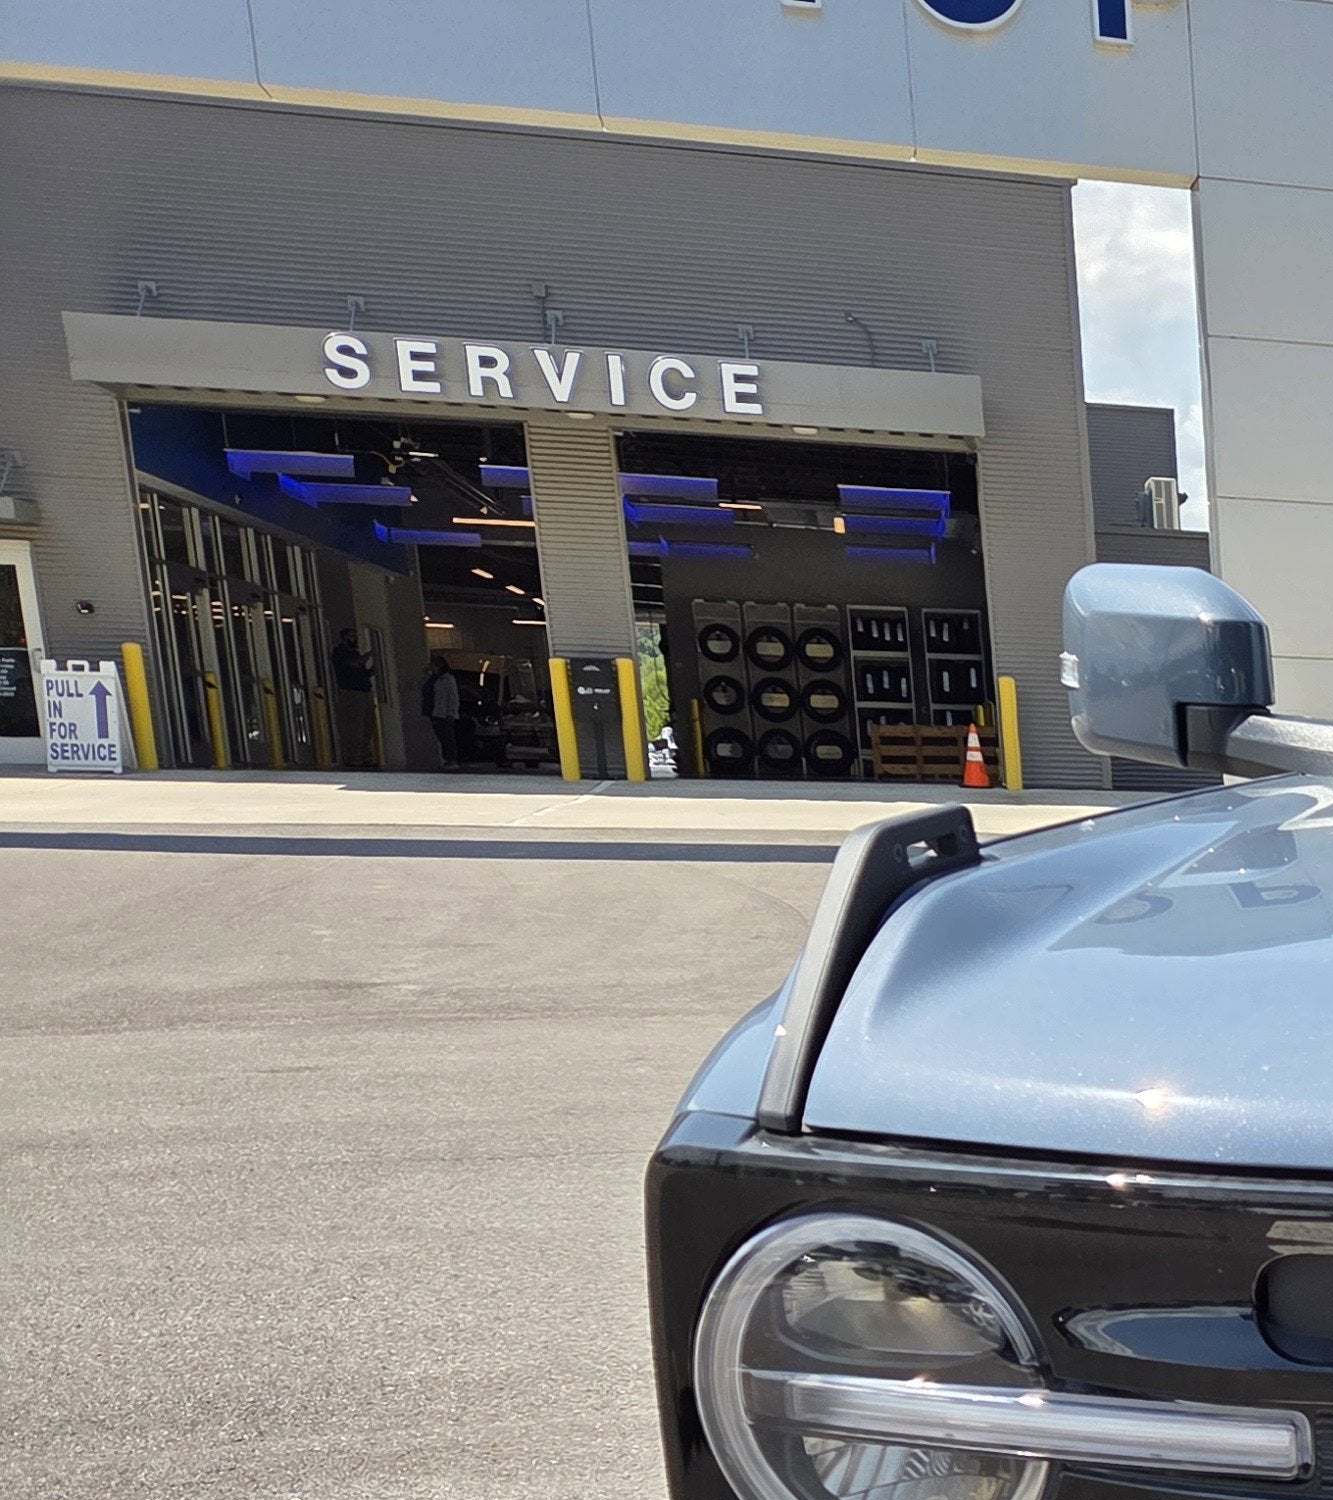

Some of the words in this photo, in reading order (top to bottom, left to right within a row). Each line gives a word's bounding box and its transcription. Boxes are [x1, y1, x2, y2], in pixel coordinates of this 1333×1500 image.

[322, 331, 764, 415] SERVICE
[46, 679, 83, 698] PULL
[48, 700, 63, 718] IN
[50, 722, 78, 740] FOR
[50, 742, 117, 761] SERVICE
